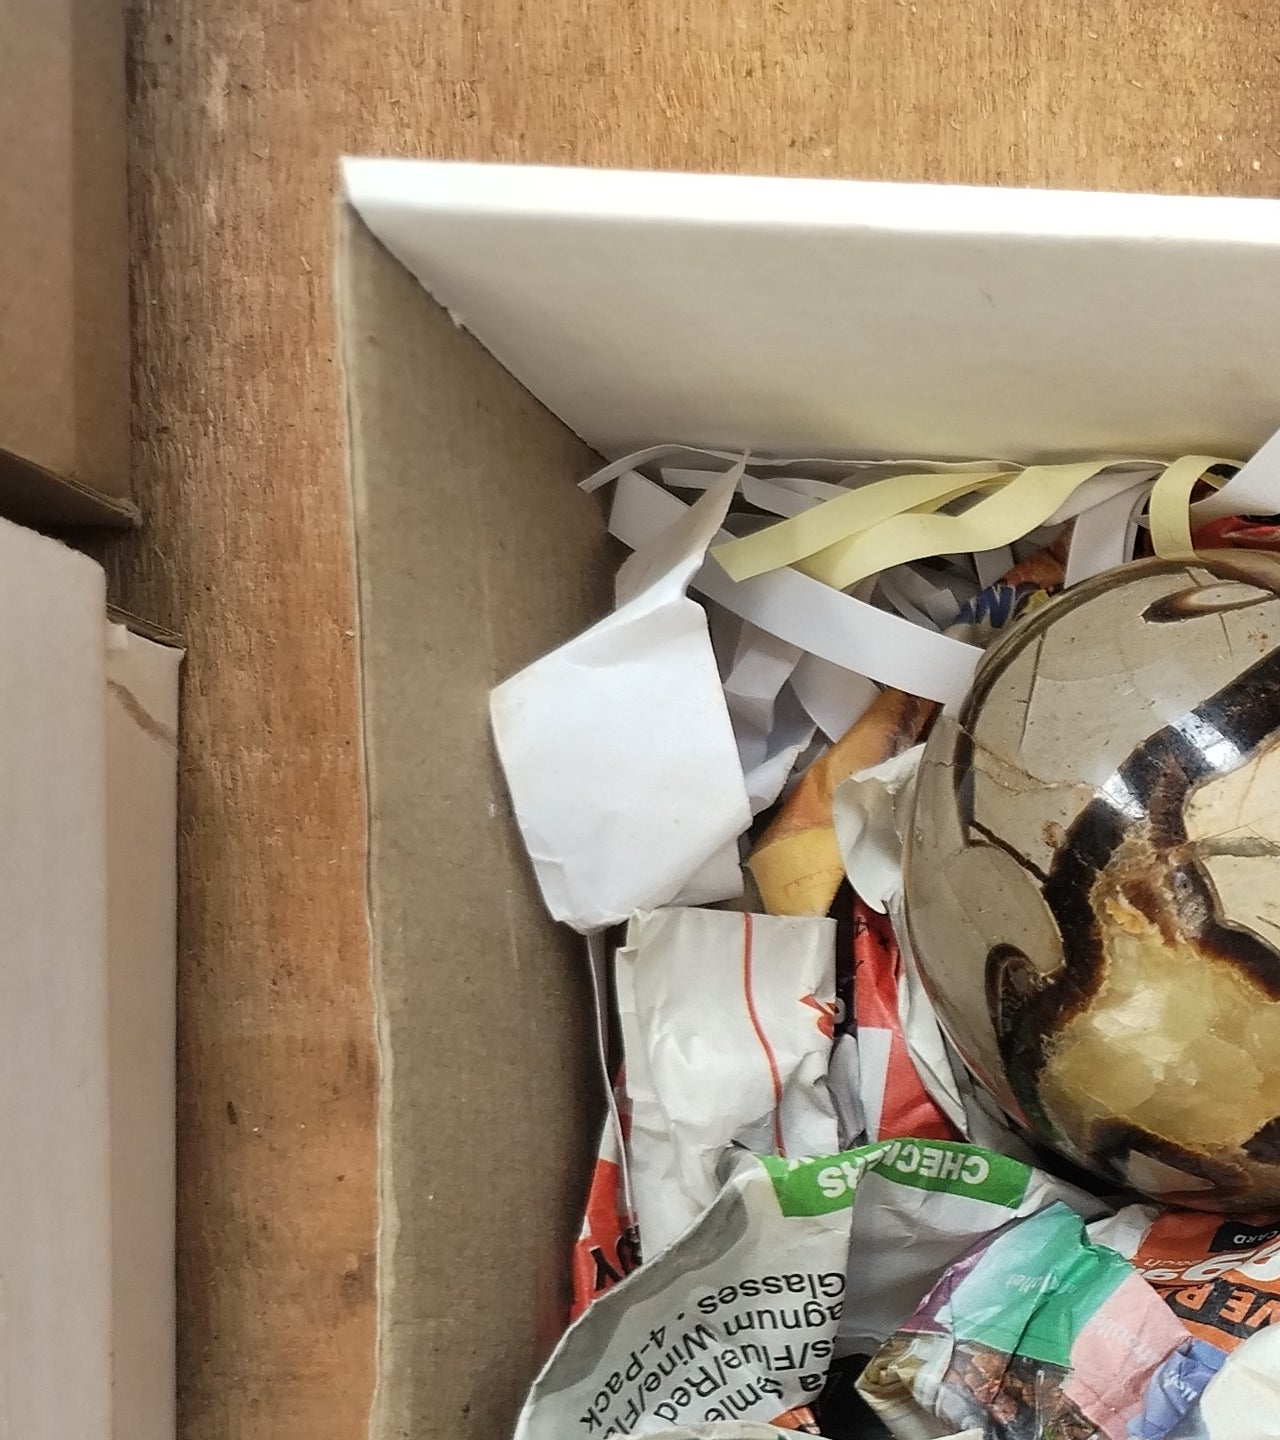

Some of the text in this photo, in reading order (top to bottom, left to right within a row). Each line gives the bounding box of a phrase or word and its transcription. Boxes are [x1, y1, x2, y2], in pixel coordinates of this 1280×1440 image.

[1234, 1229, 1279, 1246] CARD
[697, 1272, 846, 1314] Glasses
[580, 1326, 667, 1434] 4-Pack
